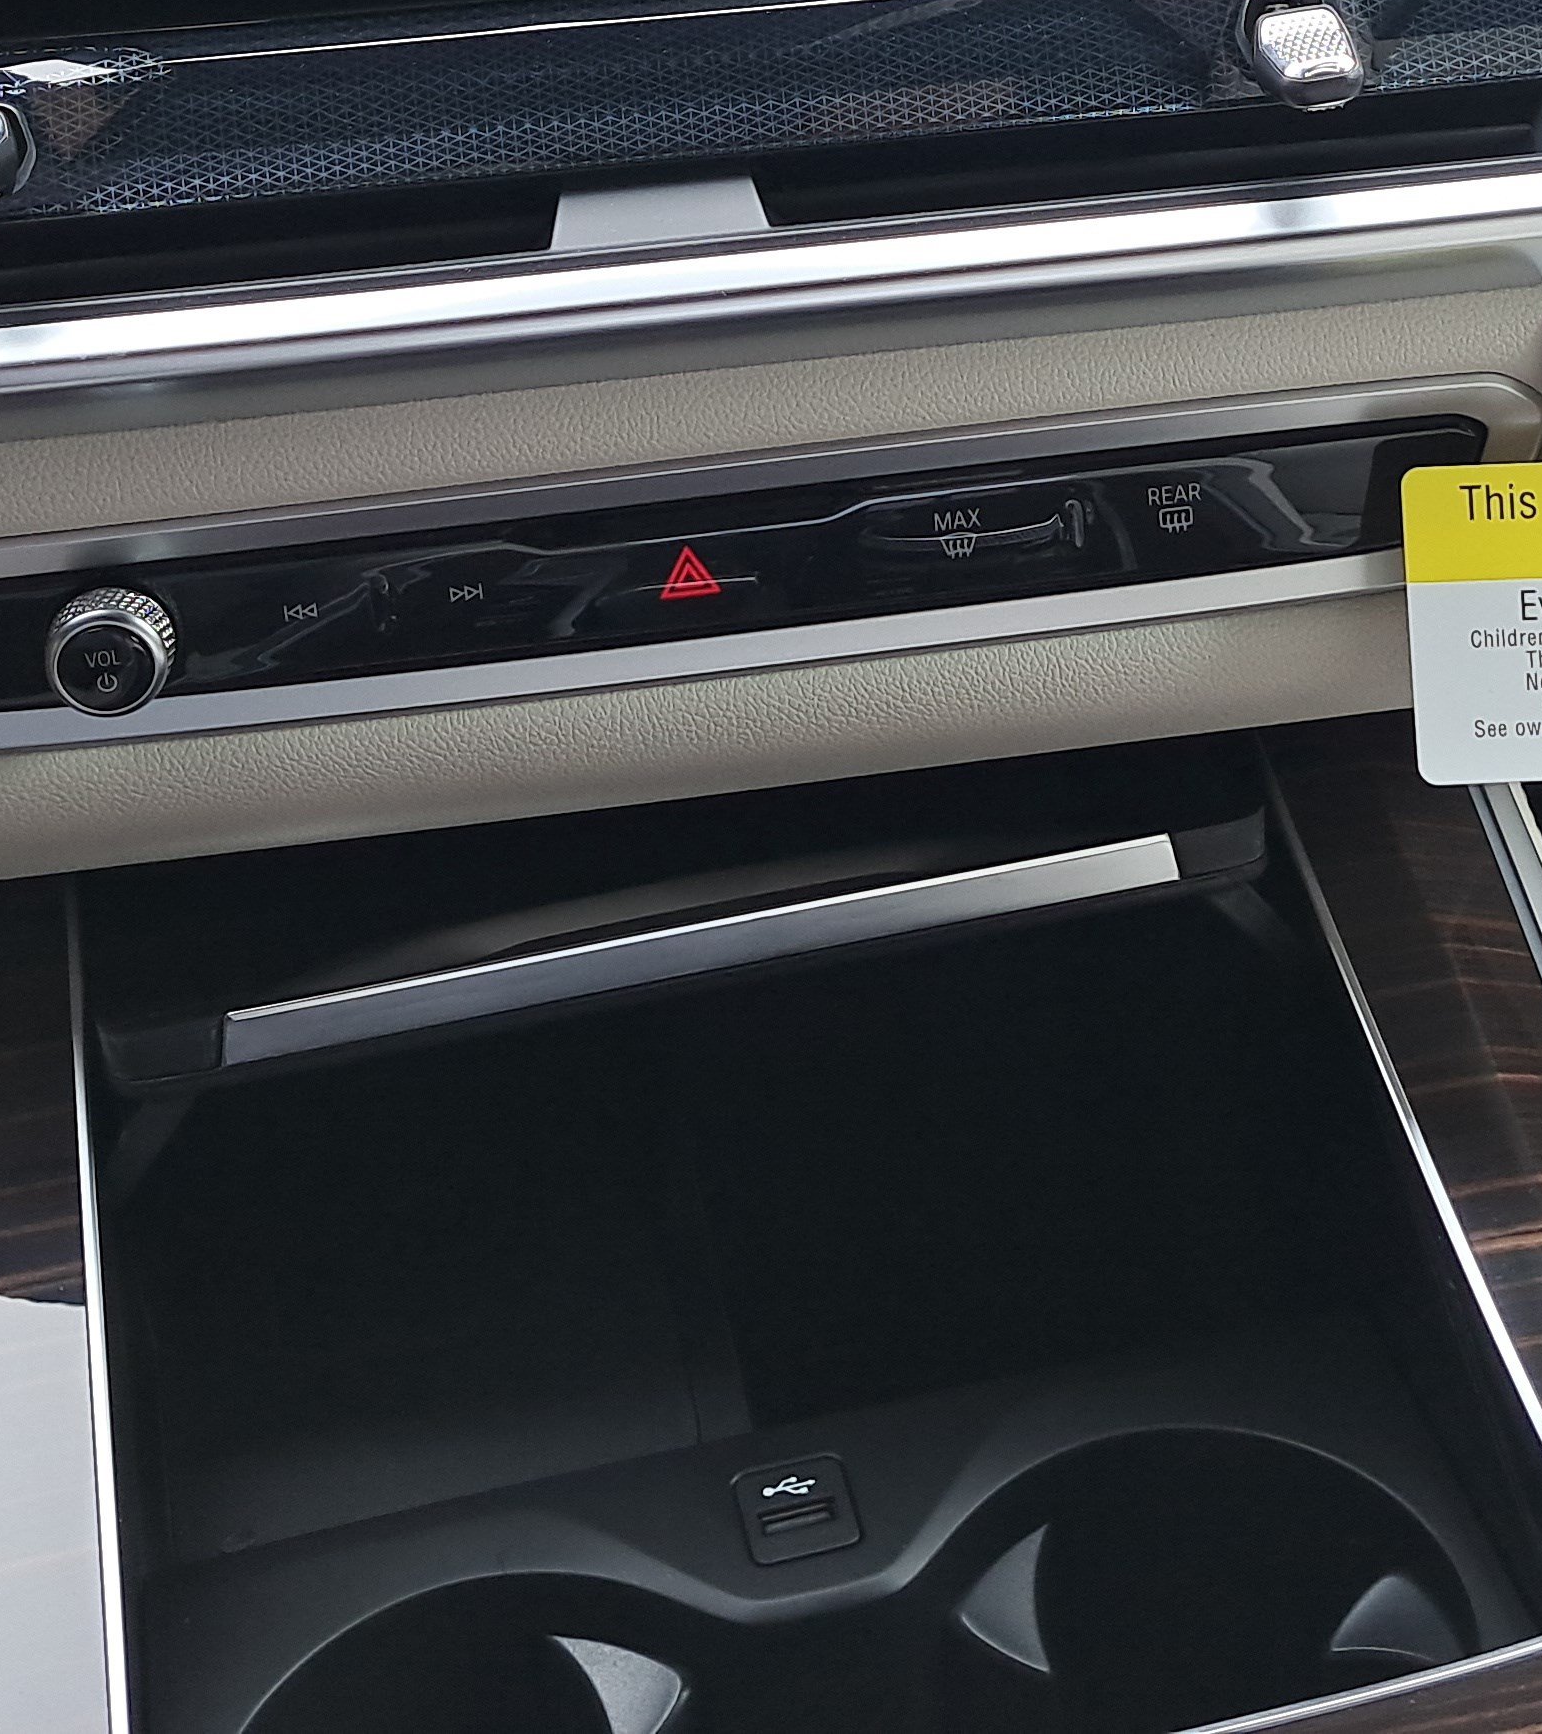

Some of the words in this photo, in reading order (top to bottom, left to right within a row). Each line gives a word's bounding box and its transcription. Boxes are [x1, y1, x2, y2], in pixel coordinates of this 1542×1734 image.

[1146, 481, 1202, 506] REAR
[1459, 483, 1538, 522] This
[933, 508, 981, 530] MAX
[84, 649, 121, 668] VOL
[1474, 719, 1508, 739] See
